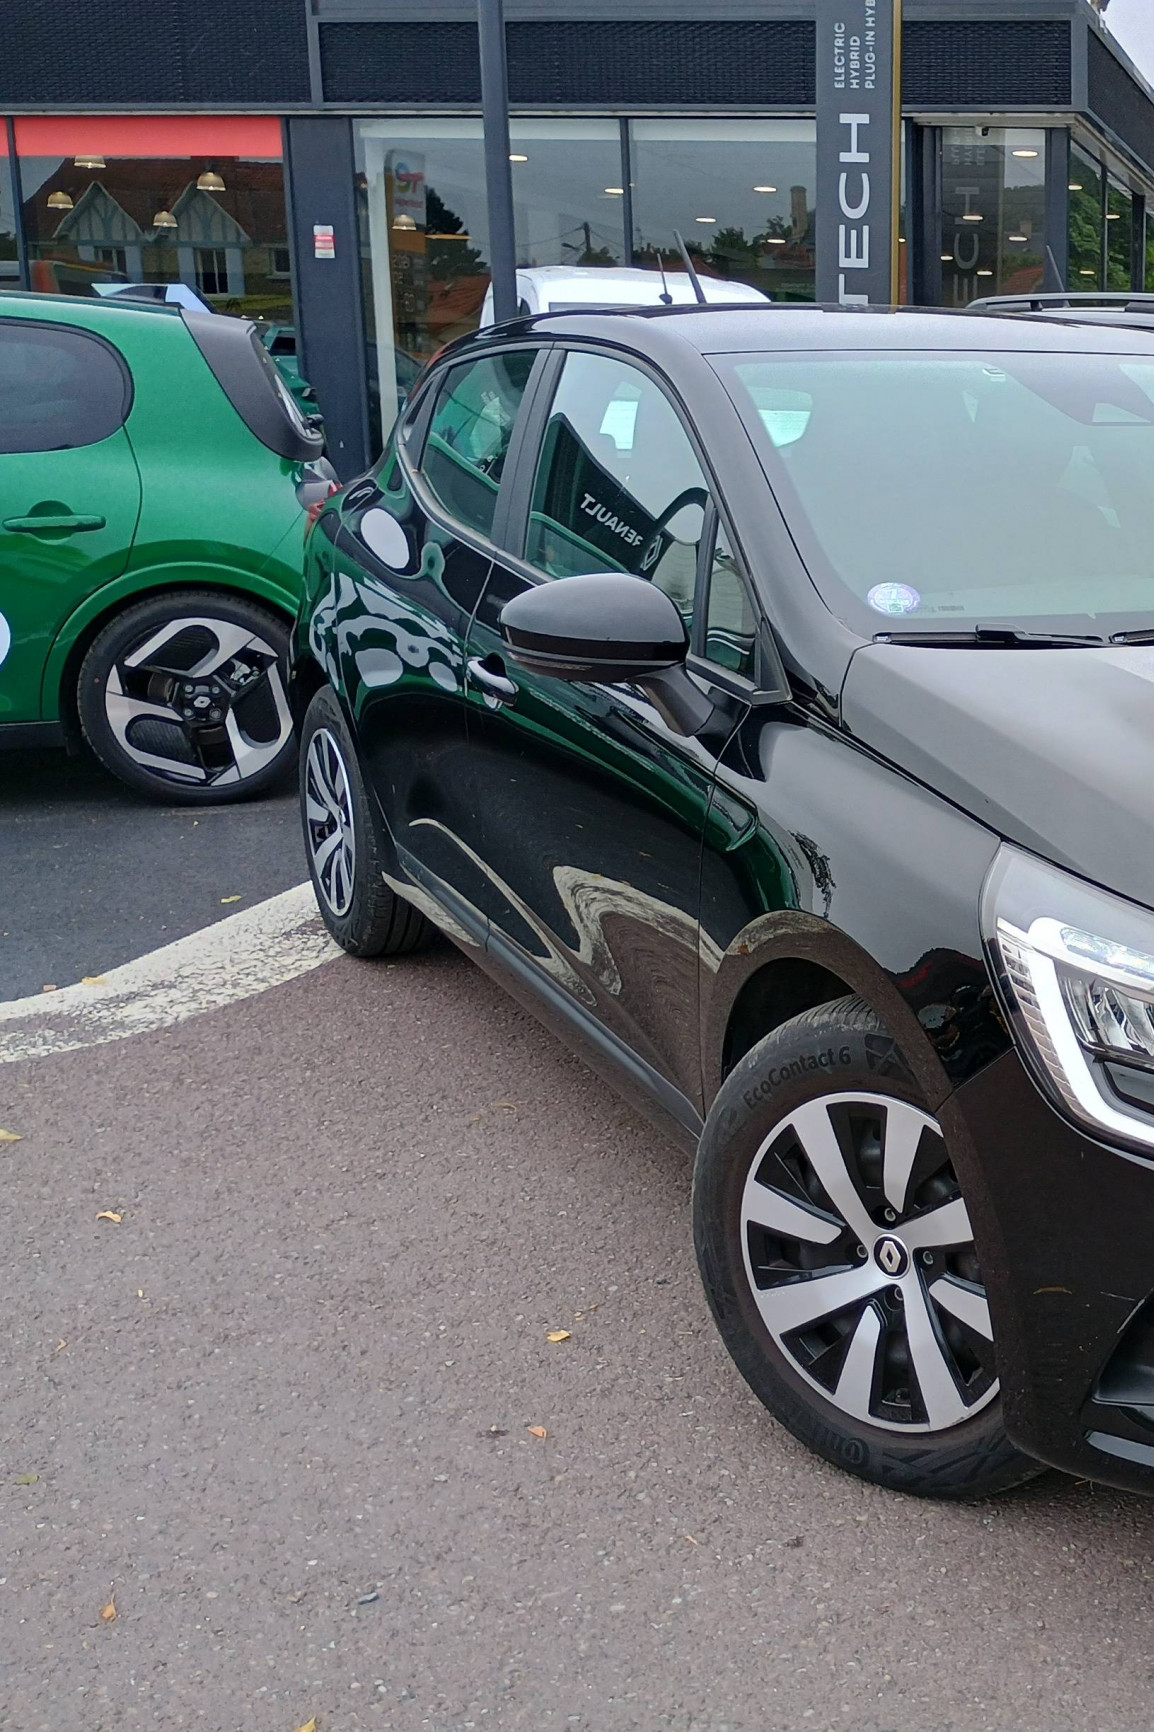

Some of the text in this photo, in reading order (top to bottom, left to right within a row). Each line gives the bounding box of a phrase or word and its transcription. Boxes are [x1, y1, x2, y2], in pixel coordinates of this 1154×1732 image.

[834, 21, 845, 89] ELECTRIC
[850, 35, 861, 89] HYBRID
[864, 30, 876, 89] PLUG-IN
[742, 1046, 851, 1109] EcoContact 6
